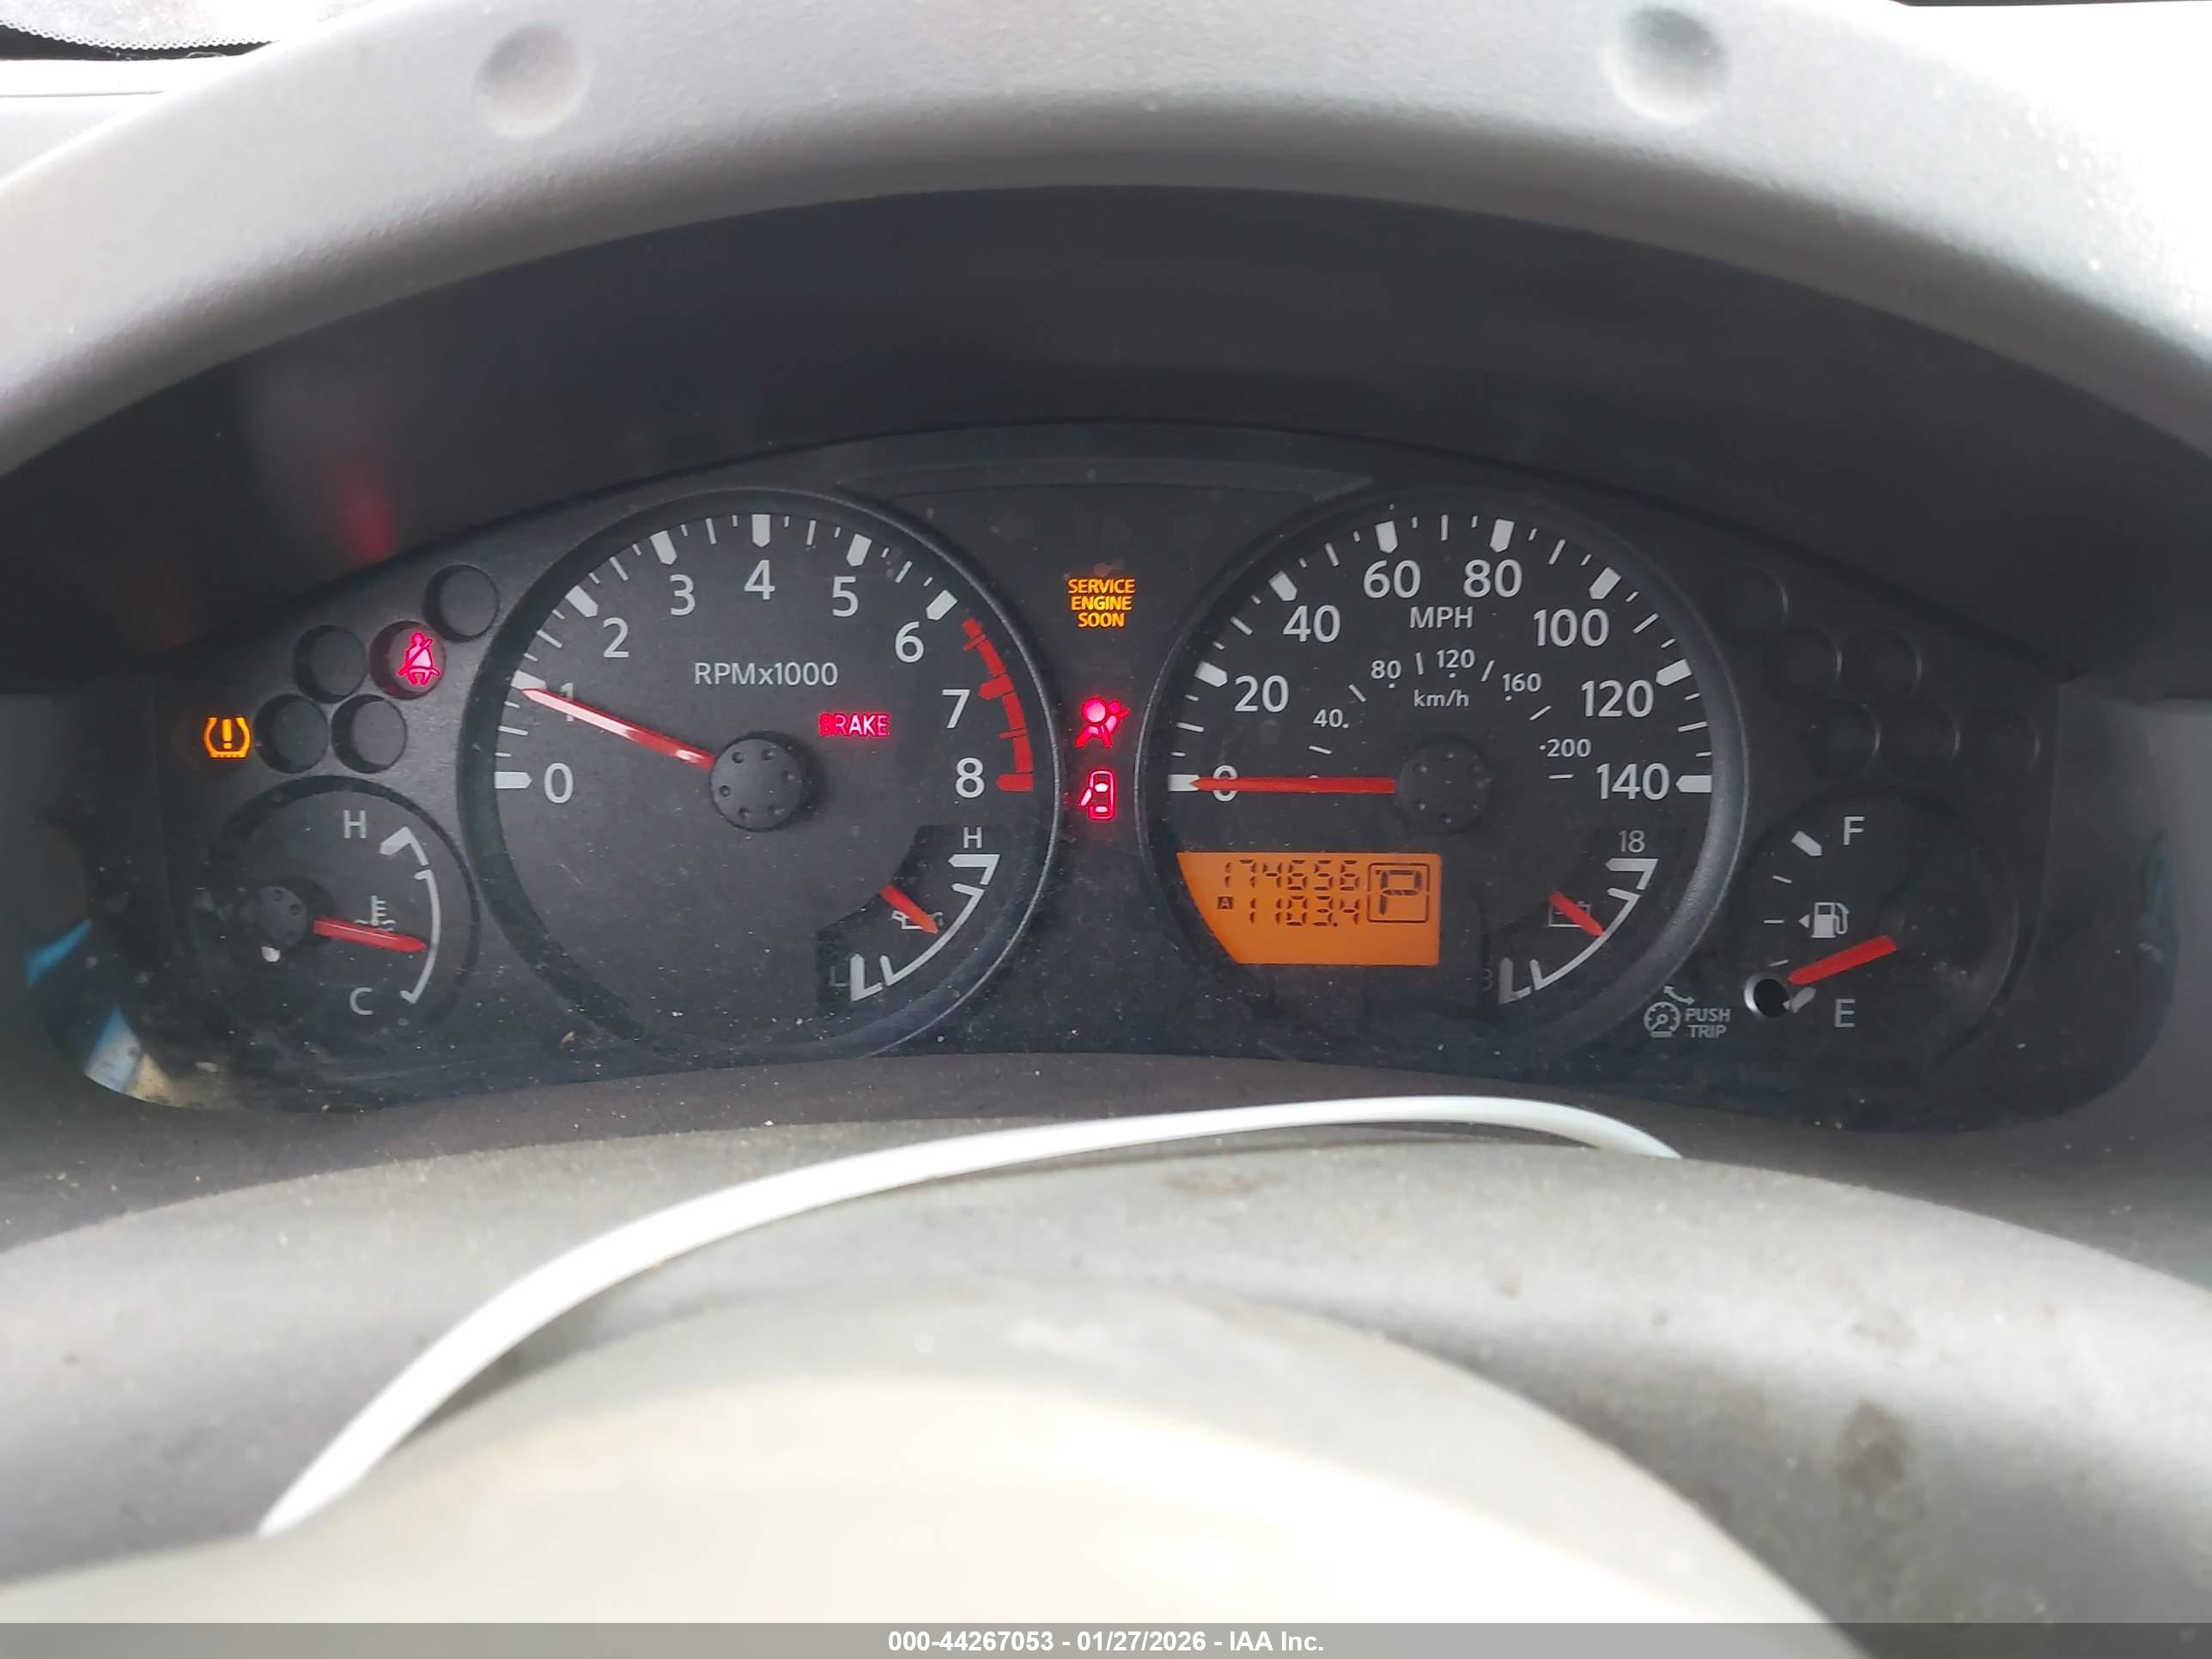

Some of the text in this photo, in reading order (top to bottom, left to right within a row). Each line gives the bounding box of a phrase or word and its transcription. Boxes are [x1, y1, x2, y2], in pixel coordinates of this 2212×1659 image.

[671, 574, 695, 615] 3
[744, 560, 775, 599] 4
[1067, 578, 1136, 593] SERVICE
[1364, 561, 1420, 598] 60
[1464, 560, 1522, 597] 80
[833, 577, 858, 617] 5
[1071, 596, 1133, 611] ENGINE
[1078, 612, 1126, 627] SOON
[1284, 605, 1340, 642] 40
[1411, 607, 1472, 628] MPH
[1534, 609, 1608, 647] 100
[604, 617, 629, 657] 2
[896, 622, 923, 662] 6
[696, 662, 837, 685] RPMx1000
[1371, 660, 1401, 678] 80
[1437, 649, 1474, 667] 120
[1235, 676, 1288, 712] 20
[1414, 690, 1468, 706] km/h
[1504, 673, 1540, 691] 160
[560, 683, 574, 721] 1
[943, 690, 969, 728] 7
[1582, 680, 1654, 717] 120
[818, 713, 890, 736] BRAKE
[1547, 739, 1590, 757] 200
[544, 763, 573, 803] 0
[956, 758, 984, 798] 8
[1213, 765, 1238, 801] 0
[1597, 763, 1668, 799] 140
[344, 811, 366, 838] H
[964, 828, 981, 848] H
[1844, 817, 1864, 845] F
[1620, 830, 1644, 853] 18
[1224, 859, 1360, 891] 174656
[1374, 869, 1422, 915] P
[1249, 895, 1360, 927] 1103.4
[350, 988, 373, 1015] C
[1686, 1008, 1730, 1022] PUSH
[1835, 999, 1855, 1027] E
[1687, 1024, 1727, 1038] TRIP
